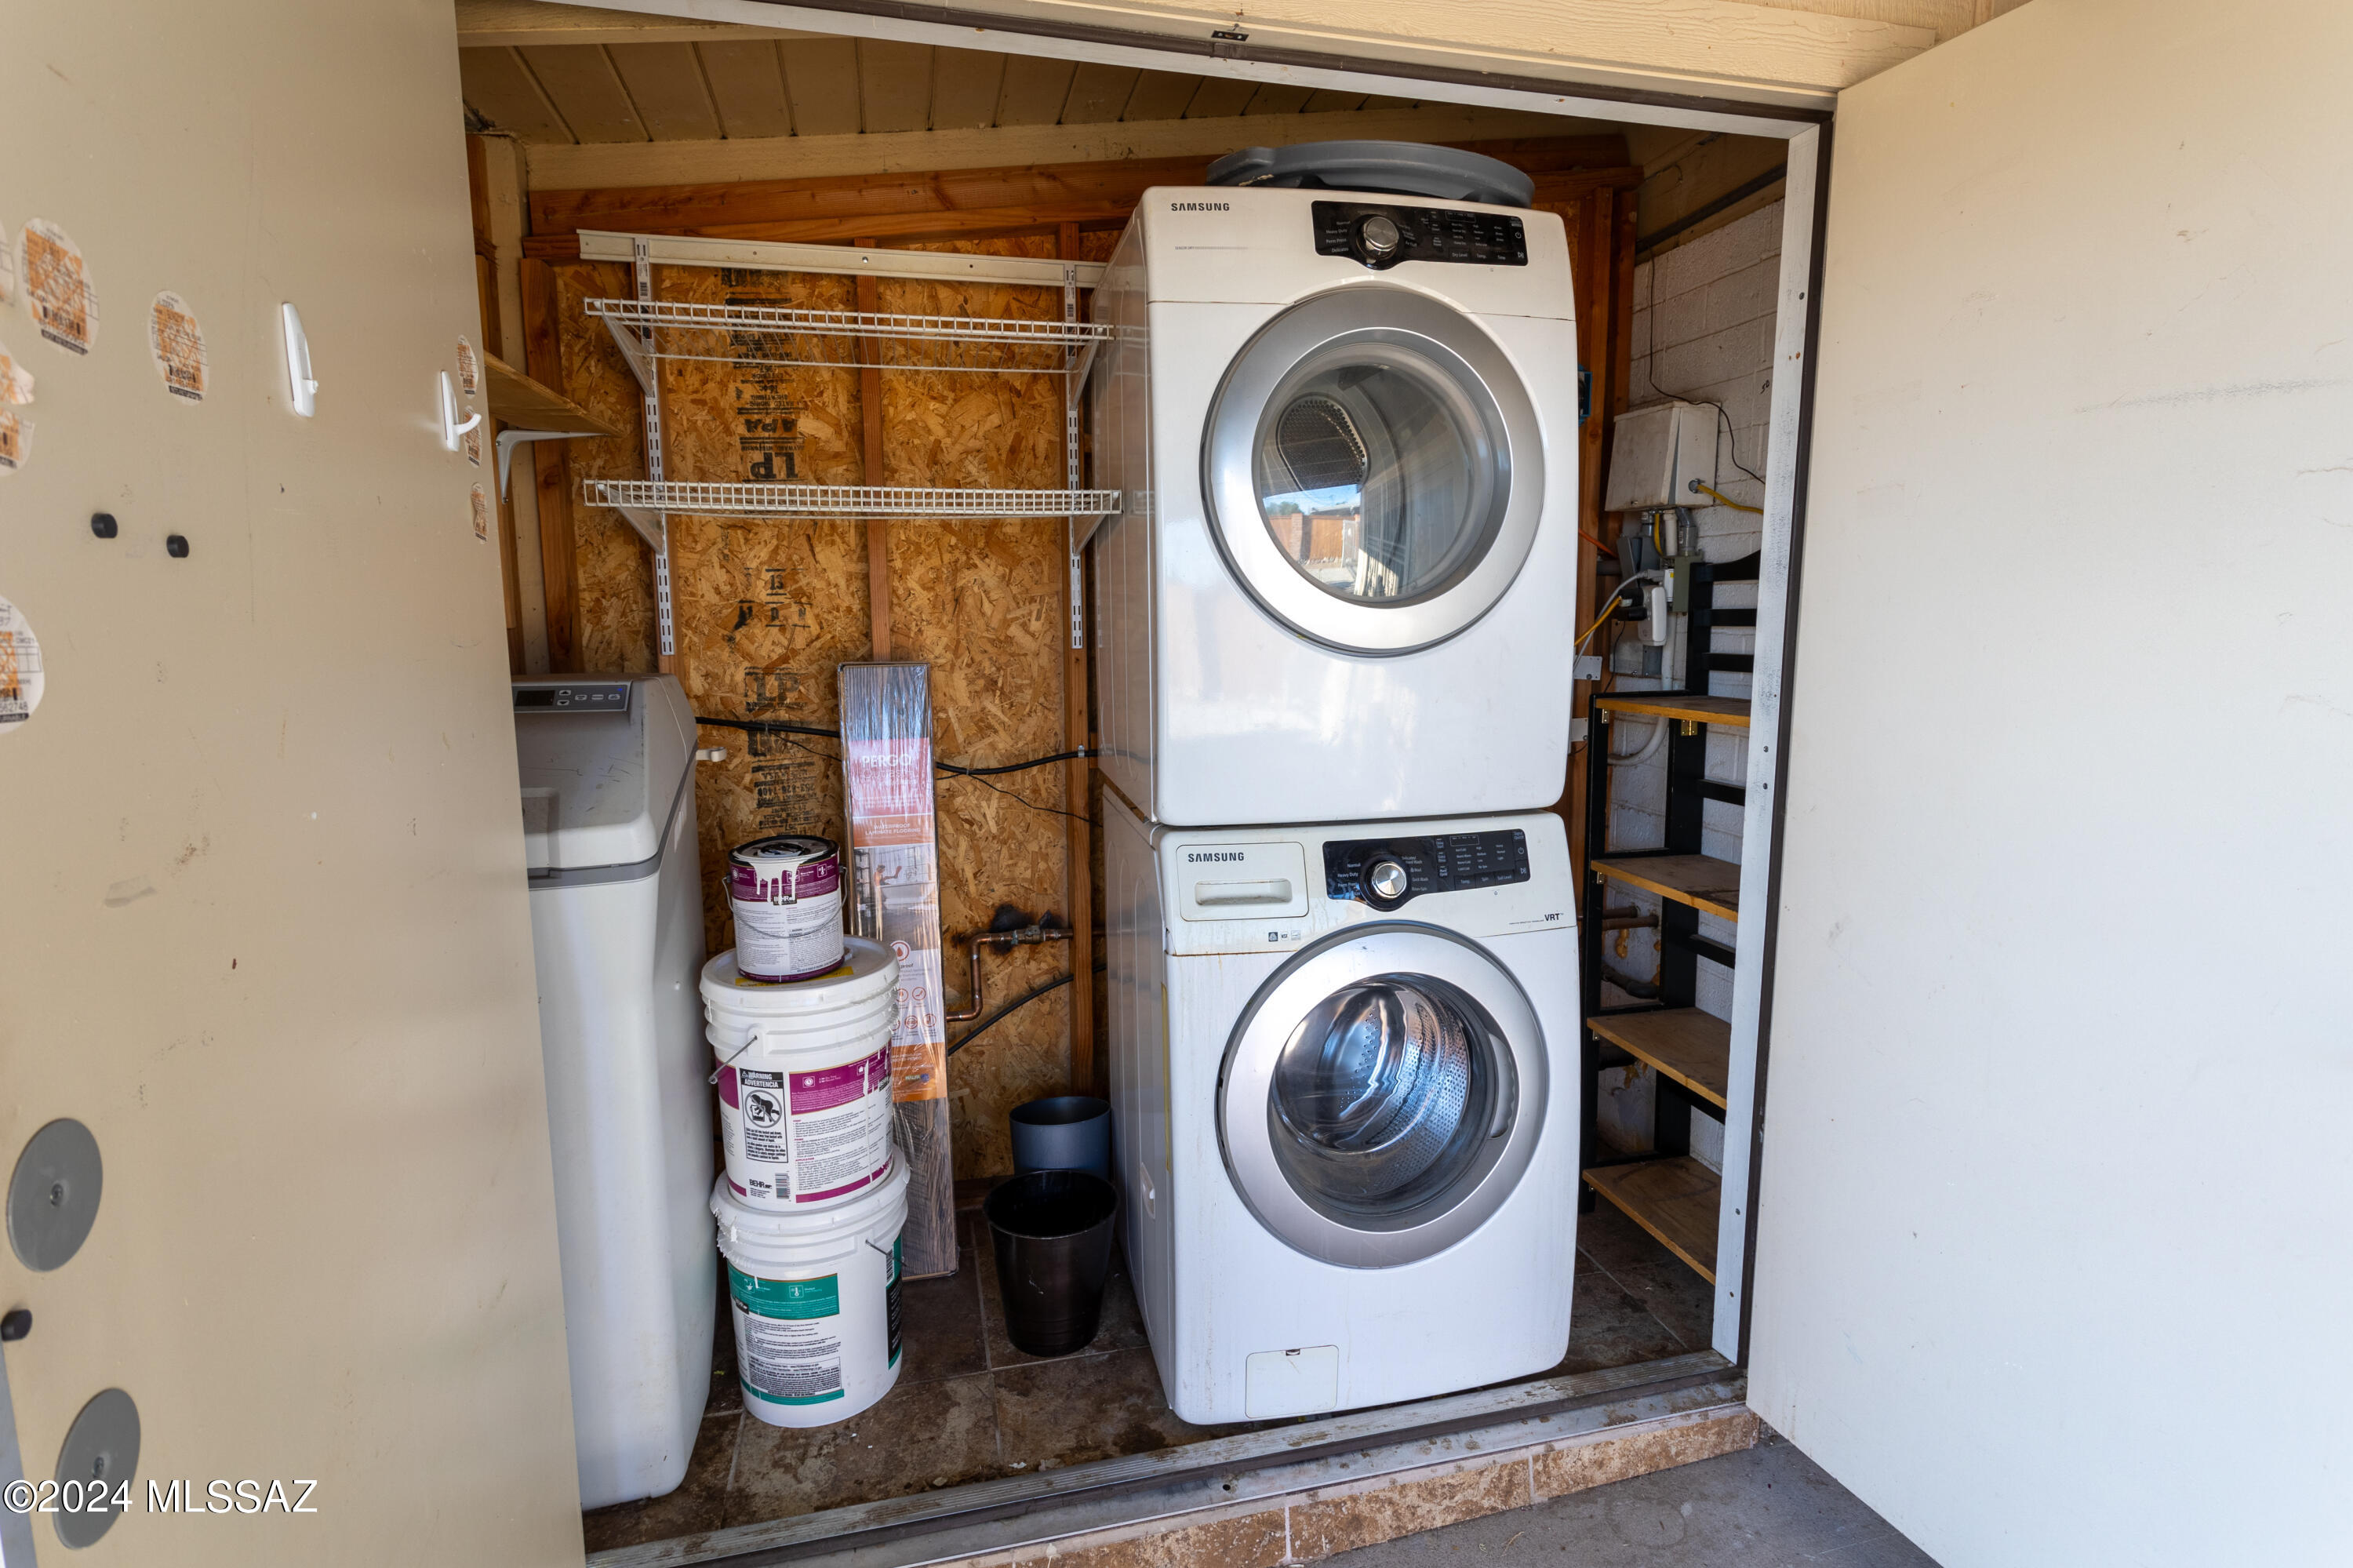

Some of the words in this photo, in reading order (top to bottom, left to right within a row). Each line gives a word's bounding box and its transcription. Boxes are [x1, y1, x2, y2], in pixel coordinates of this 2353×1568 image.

[1171, 202, 1230, 212] SAMSUNG
[744, 419, 795, 434] APA
[750, 452, 798, 479] LP
[754, 675, 800, 702] LP
[862, 754, 912, 768] PERGO
[1188, 852, 1245, 863] SAMSUNG
[744, 1079, 779, 1088] ADVERTENCIA
[749, 1179, 765, 1188] BEHR
